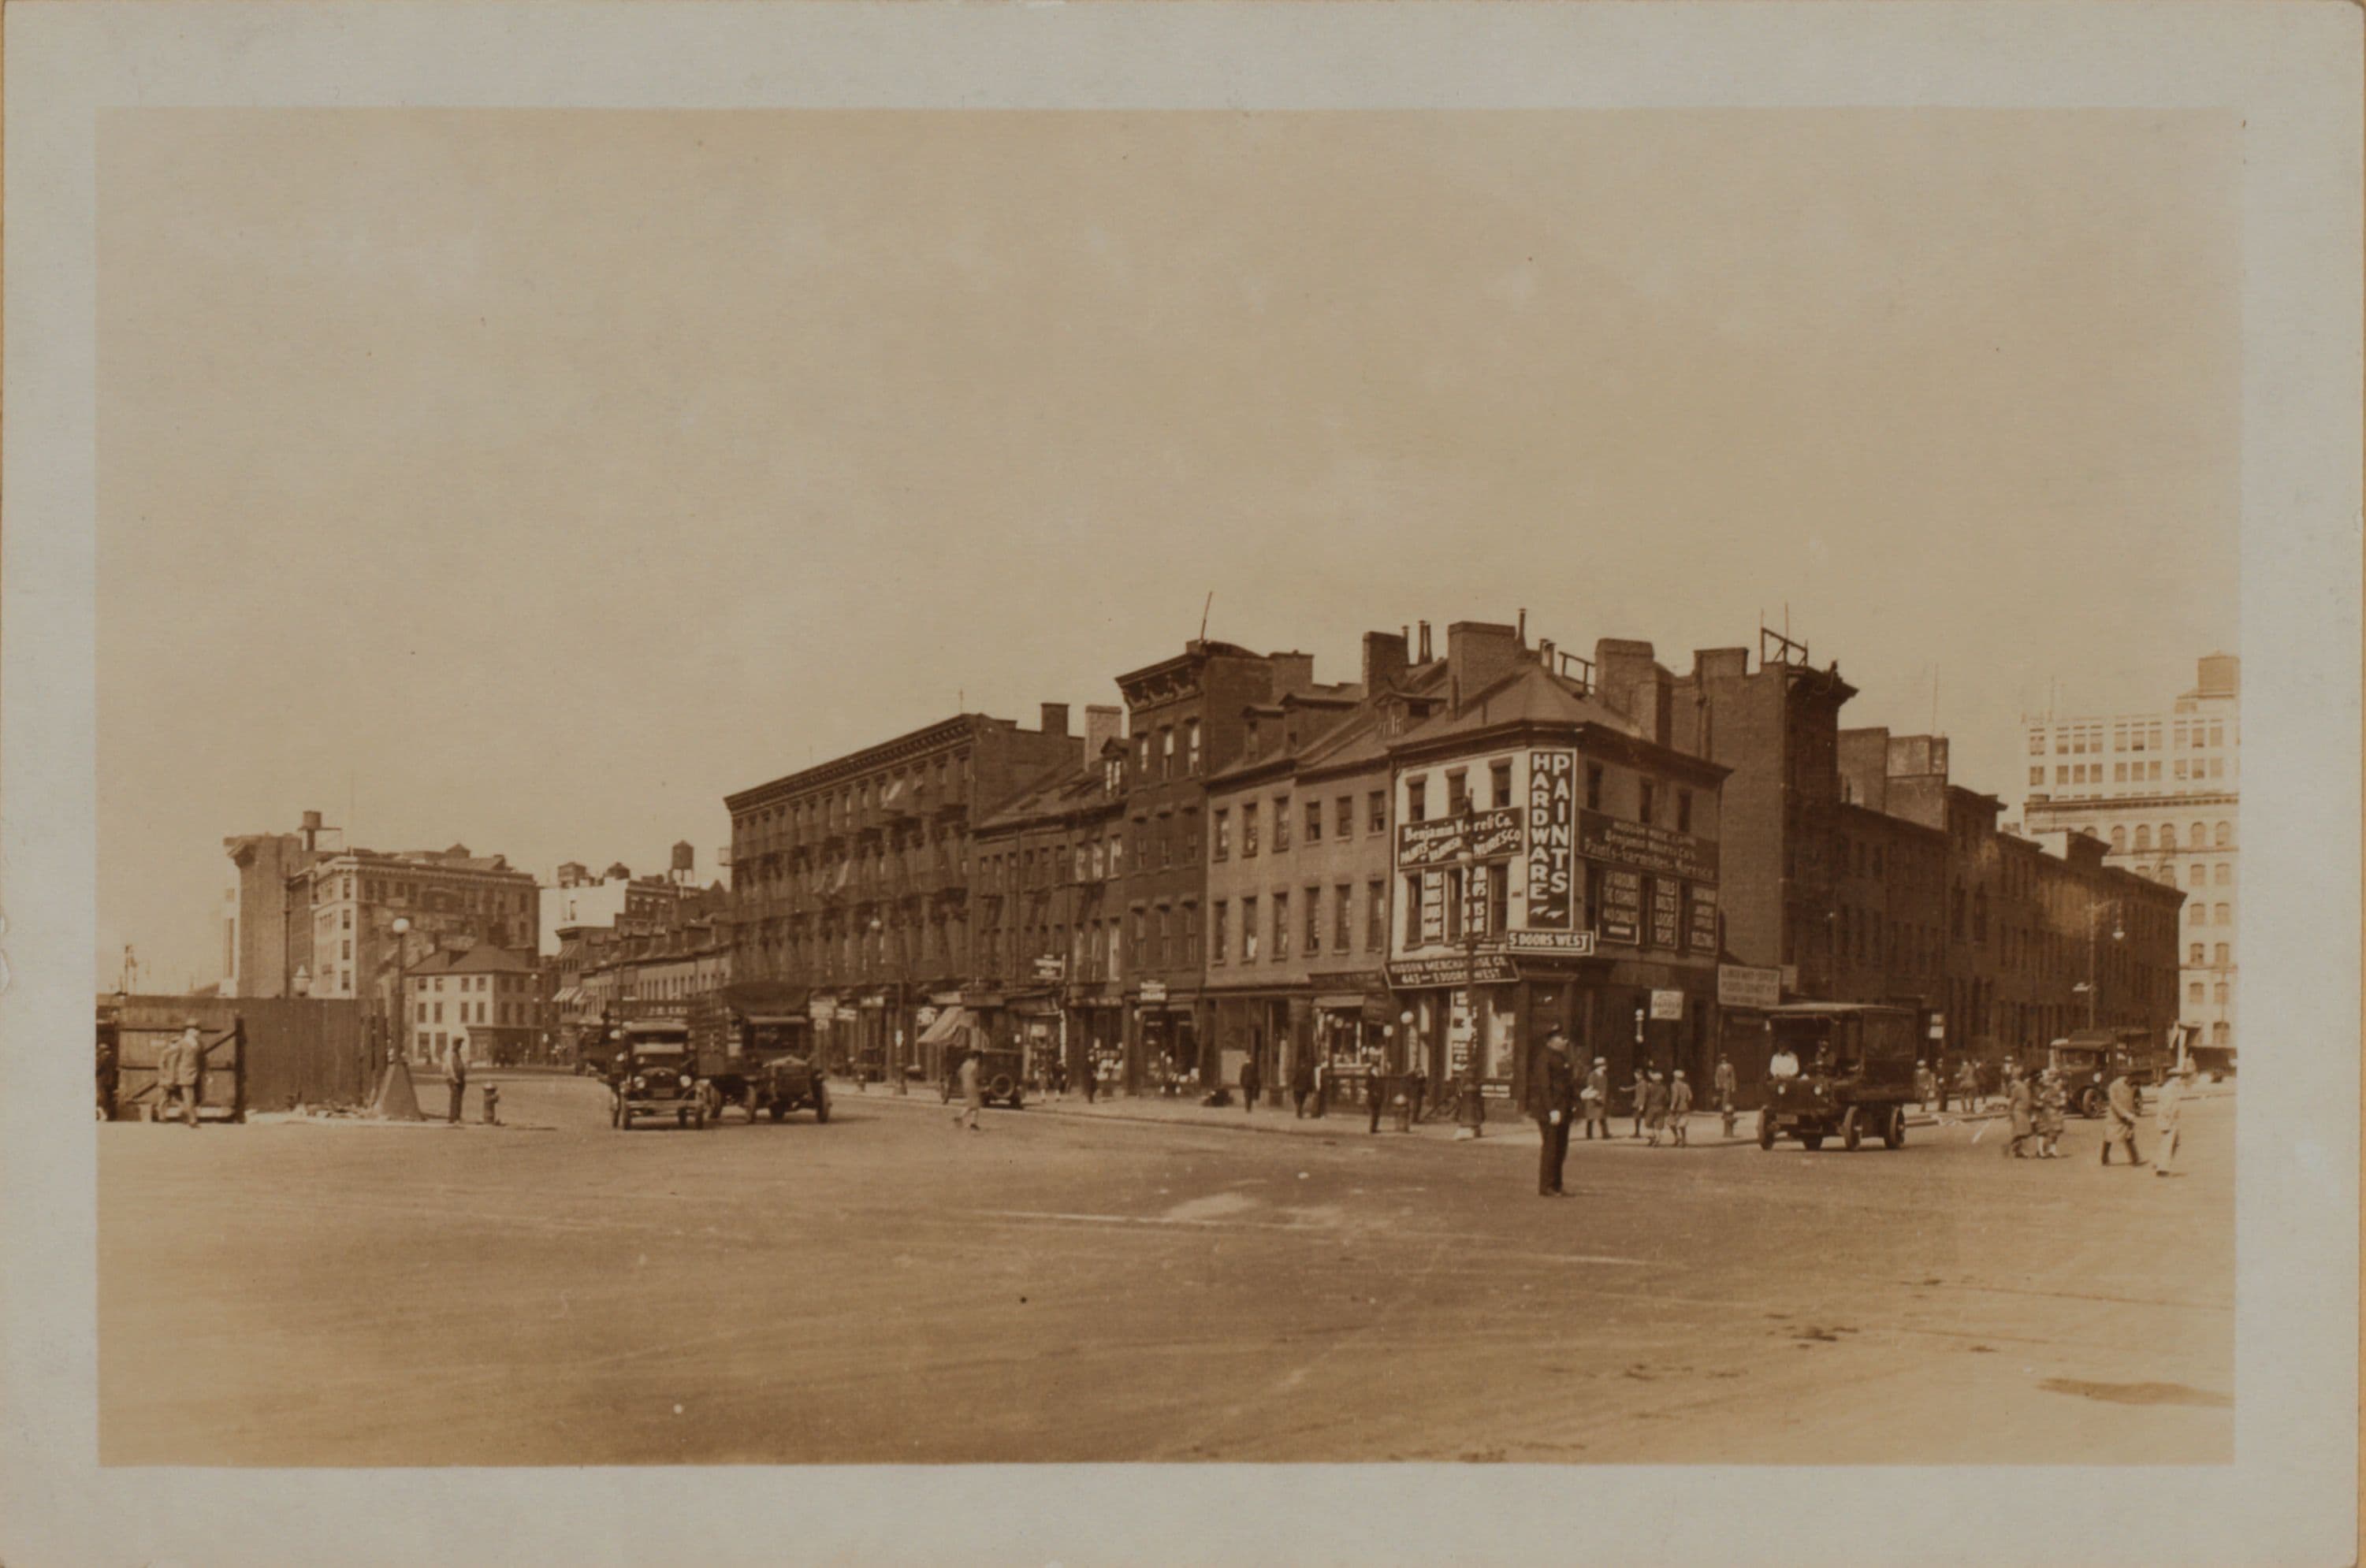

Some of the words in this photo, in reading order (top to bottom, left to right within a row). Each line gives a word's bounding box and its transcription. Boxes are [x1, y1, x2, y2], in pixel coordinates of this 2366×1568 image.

[1404, 822, 1455, 843] Benjamin
[1530, 753, 1549, 899] HARDWARE
[1550, 753, 1571, 894] PAINTS
[1508, 933, 1516, 946] 5
[1518, 933, 1553, 946] DOORS
[1555, 934, 1587, 948] WEST
[1424, 956, 1491, 972] MERCHAISE
